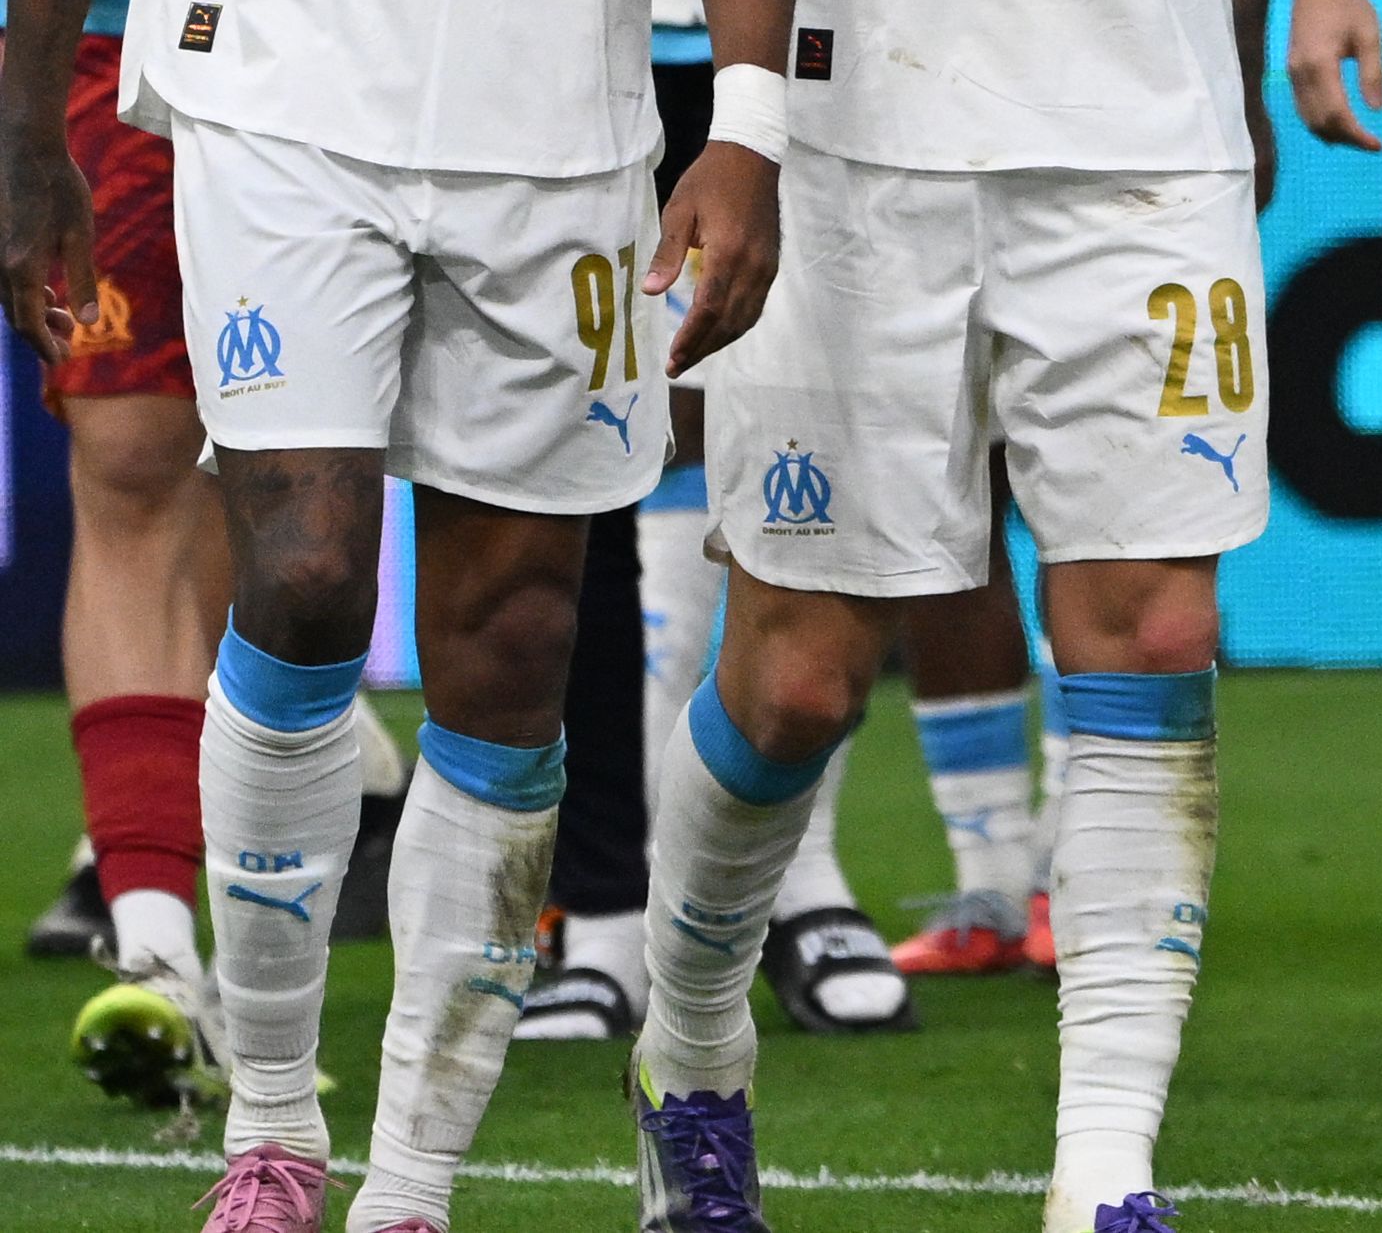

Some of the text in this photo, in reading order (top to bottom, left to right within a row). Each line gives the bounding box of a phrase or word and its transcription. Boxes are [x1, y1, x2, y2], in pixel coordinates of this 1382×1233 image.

[570, 240, 639, 392] 91
[1147, 277, 1254, 417] 28
[220, 380, 287, 400] DROIT AU BUT
[762, 527, 836, 536] DROIT AU BUT
[238, 851, 303, 873] OM
[1173, 903, 1208, 924] O
